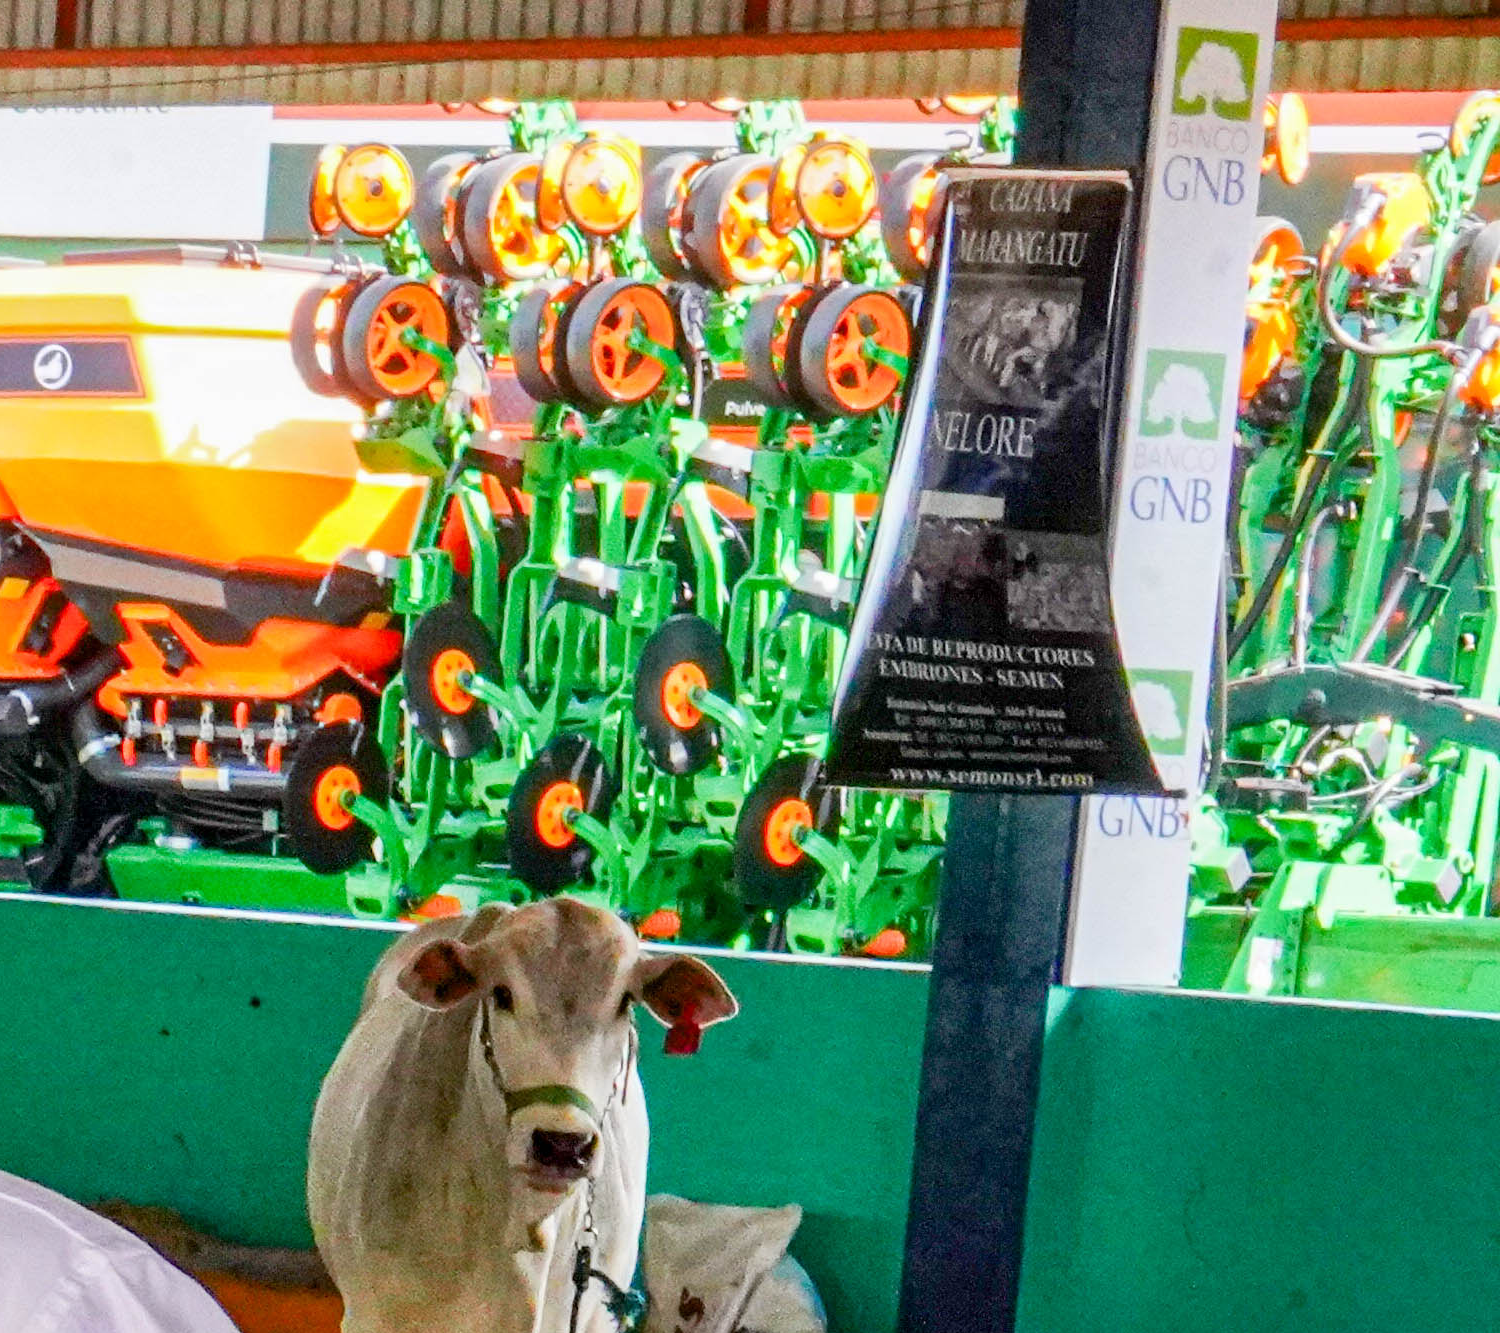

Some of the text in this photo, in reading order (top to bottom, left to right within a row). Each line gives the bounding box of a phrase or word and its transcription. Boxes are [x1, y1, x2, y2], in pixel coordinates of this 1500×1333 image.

[1167, 121, 1248, 154] BANCO
[1164, 155, 1244, 206] GNB
[934, 410, 1037, 459] NELORE
[1130, 475, 1213, 524] GNB
[879, 658, 983, 686] EMBRIONES
[996, 668, 1065, 689] SEMEN
[931, 637, 1095, 669] REPRODUCTORES
[1097, 796, 1181, 838] GNB
